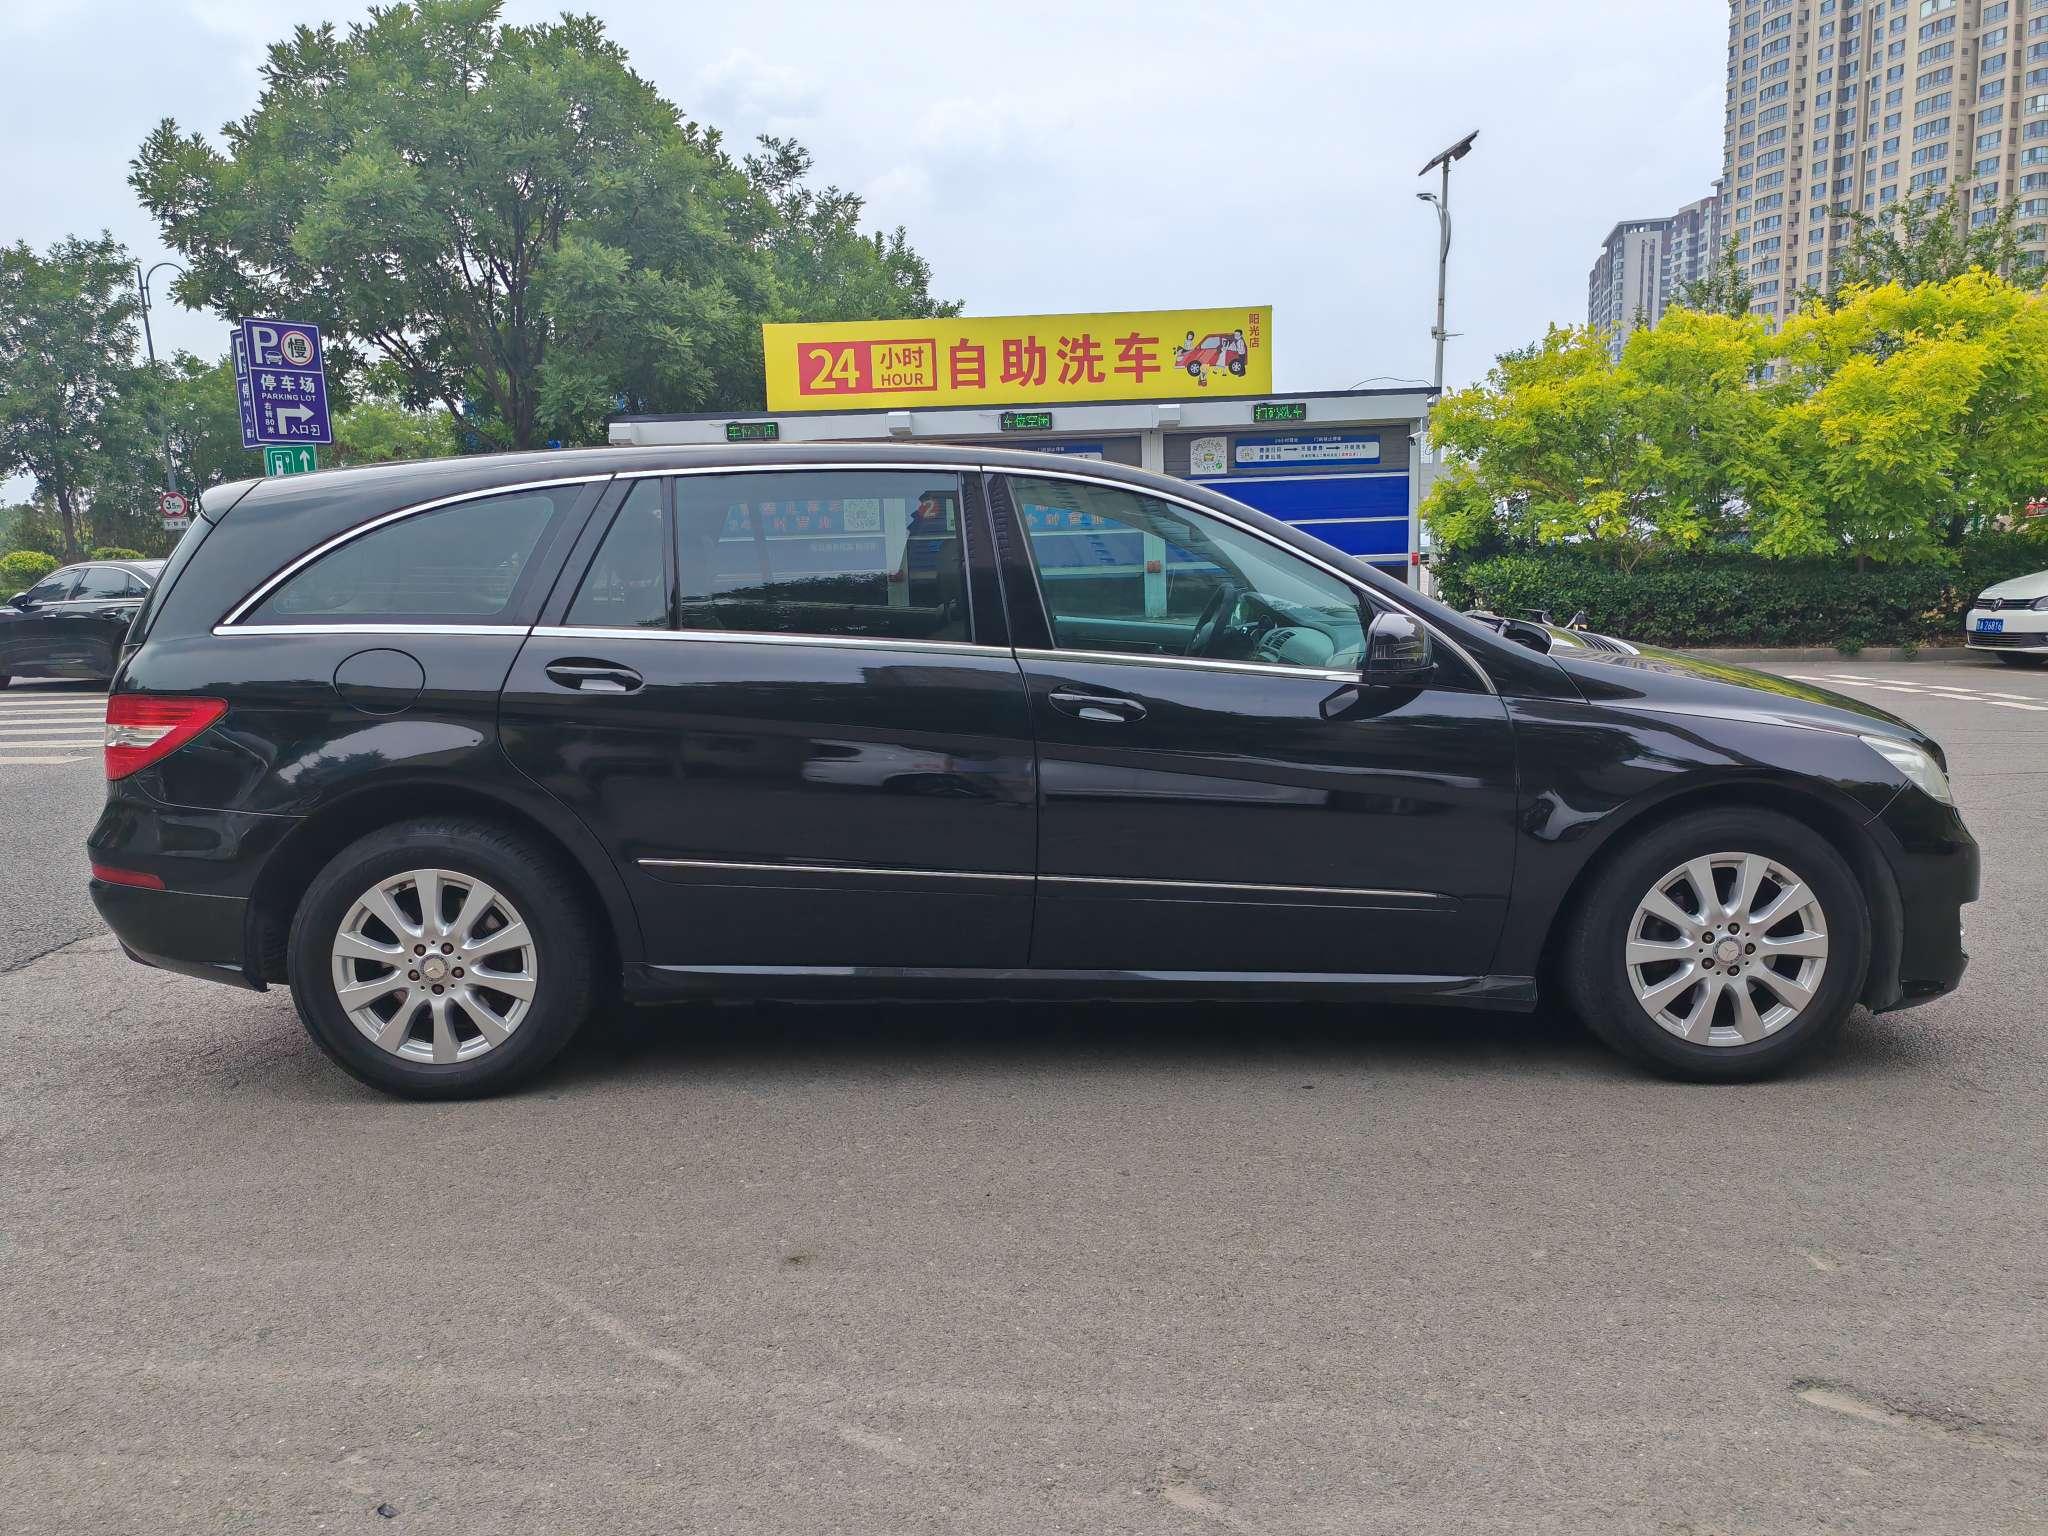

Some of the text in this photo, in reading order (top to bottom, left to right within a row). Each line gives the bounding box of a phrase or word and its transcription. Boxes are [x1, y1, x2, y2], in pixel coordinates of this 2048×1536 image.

[1248, 312, 1260, 349] 阳光店
[252, 326, 279, 364] P
[287, 337, 307, 359] 慢
[808, 348, 860, 390] 24
[880, 346, 924, 370] 小时
[949, 331, 1161, 390] 自助洗车
[260, 373, 315, 394] 停车场
[880, 372, 924, 387] HOUR
[261, 392, 317, 402] PARKING LOT
[290, 425, 309, 434] 入口
